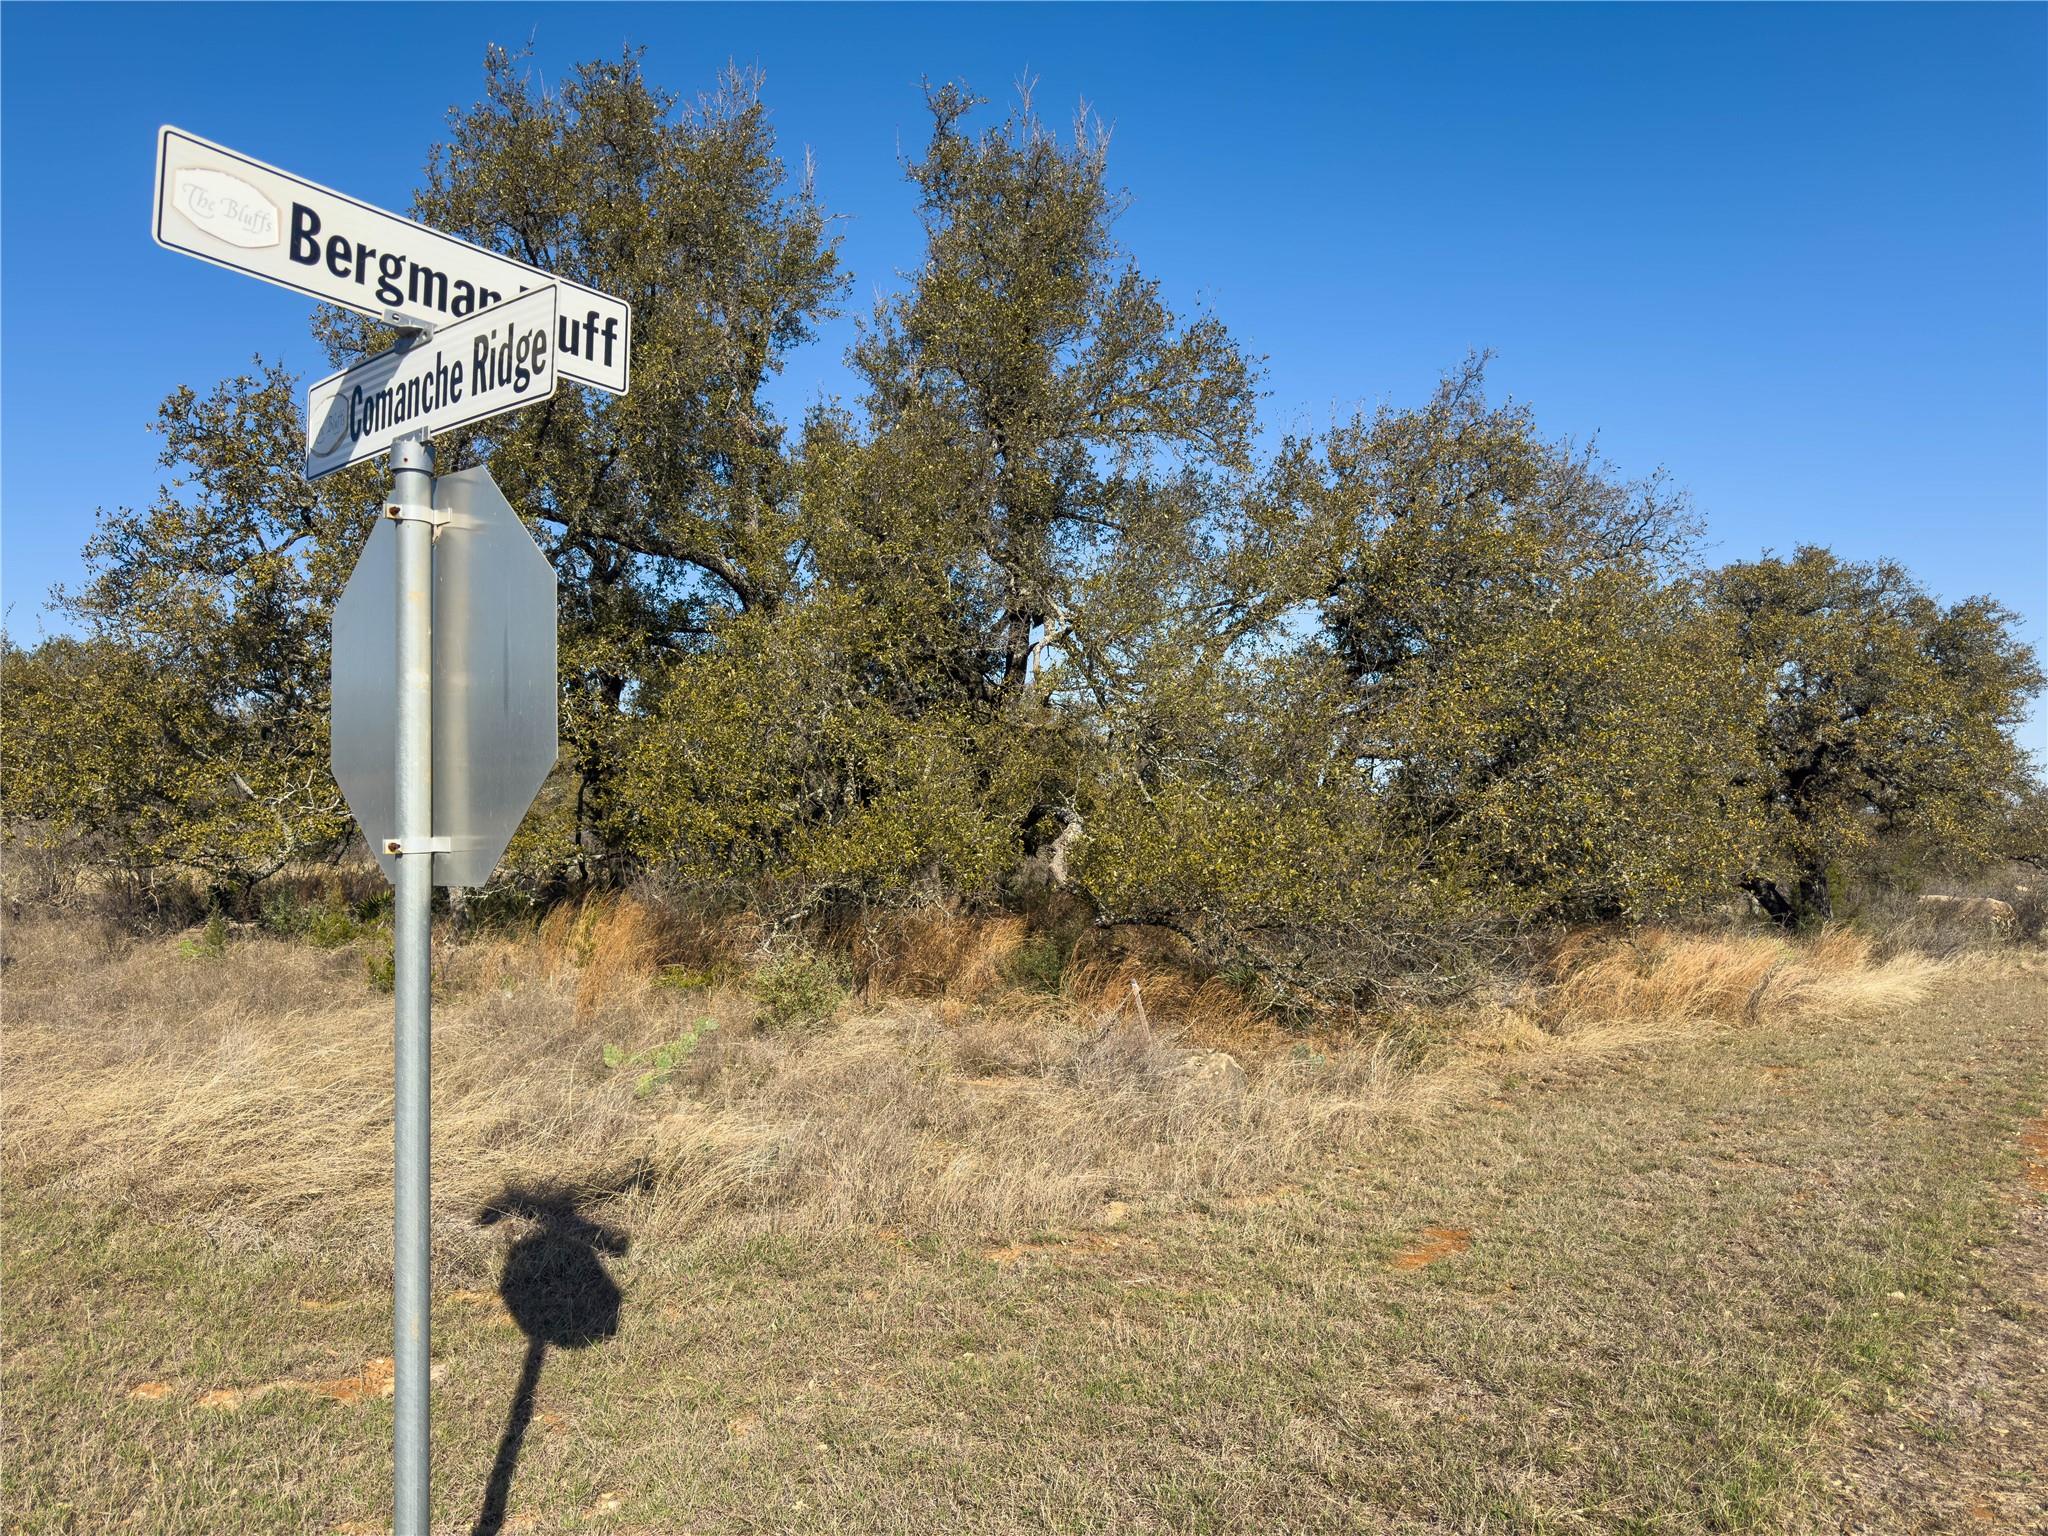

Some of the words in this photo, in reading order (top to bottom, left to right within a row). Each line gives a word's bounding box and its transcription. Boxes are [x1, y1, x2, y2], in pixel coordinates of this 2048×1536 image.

[182, 183, 215, 219] The
[220, 196, 273, 234] Bluffs
[350, 351, 463, 442] Comanche
[471, 322, 547, 393] Ridge
